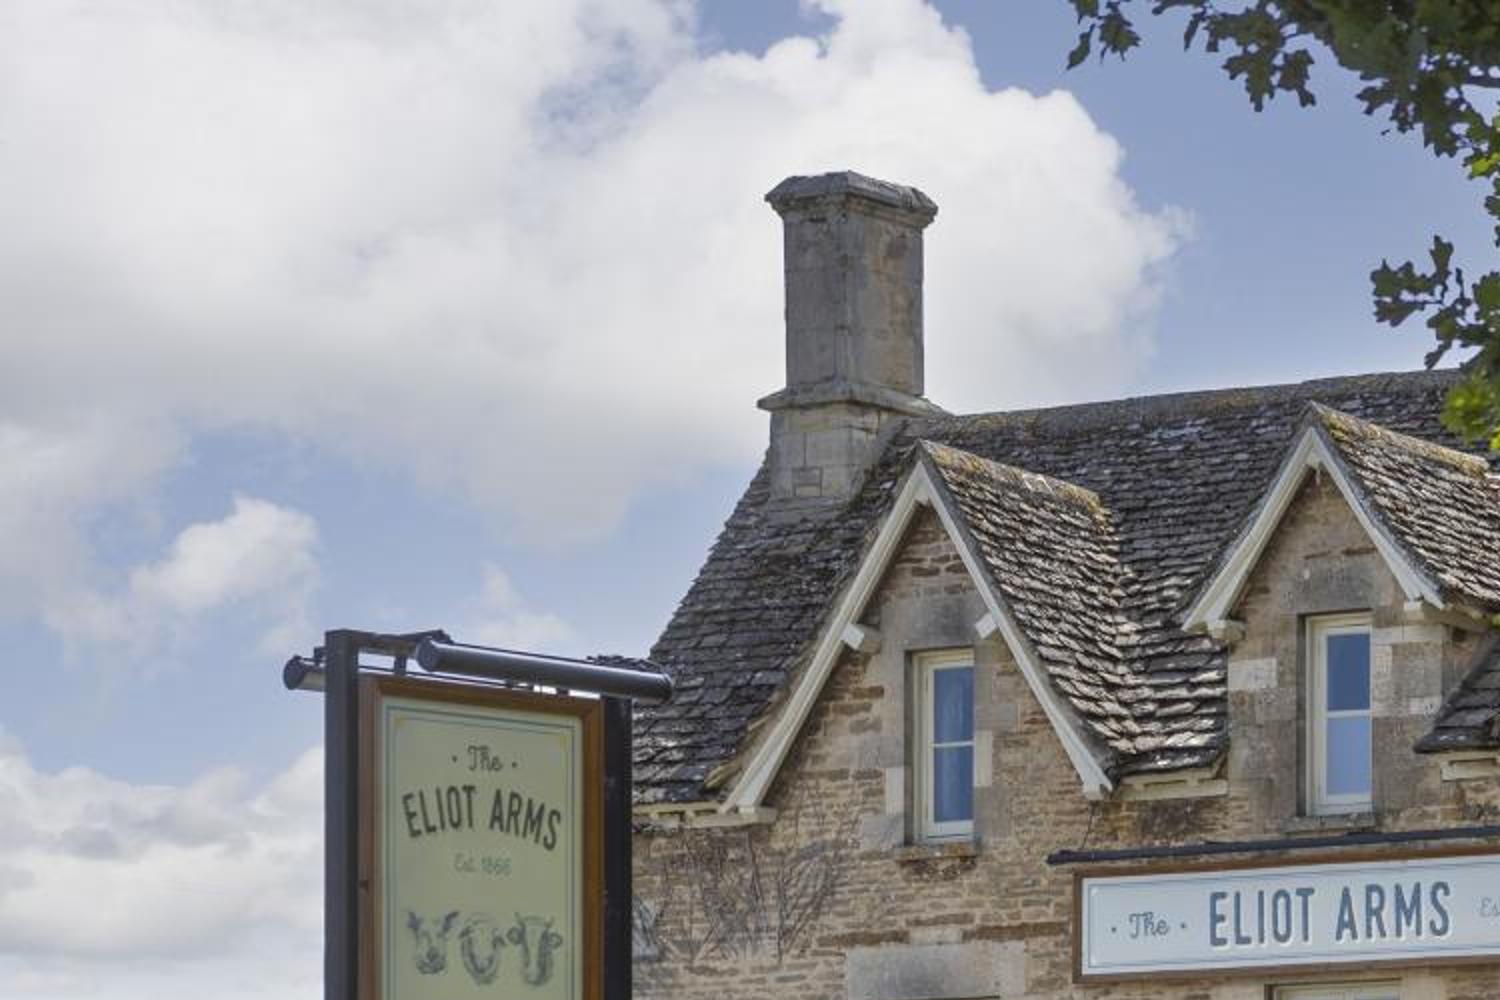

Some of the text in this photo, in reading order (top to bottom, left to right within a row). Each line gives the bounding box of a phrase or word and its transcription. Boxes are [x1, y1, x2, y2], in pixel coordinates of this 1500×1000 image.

[466, 744, 504, 773] The
[401, 784, 561, 851] ELIOT ARMS
[1128, 911, 1170, 940] The
[1208, 880, 1452, 947] ELIOT ARMS
